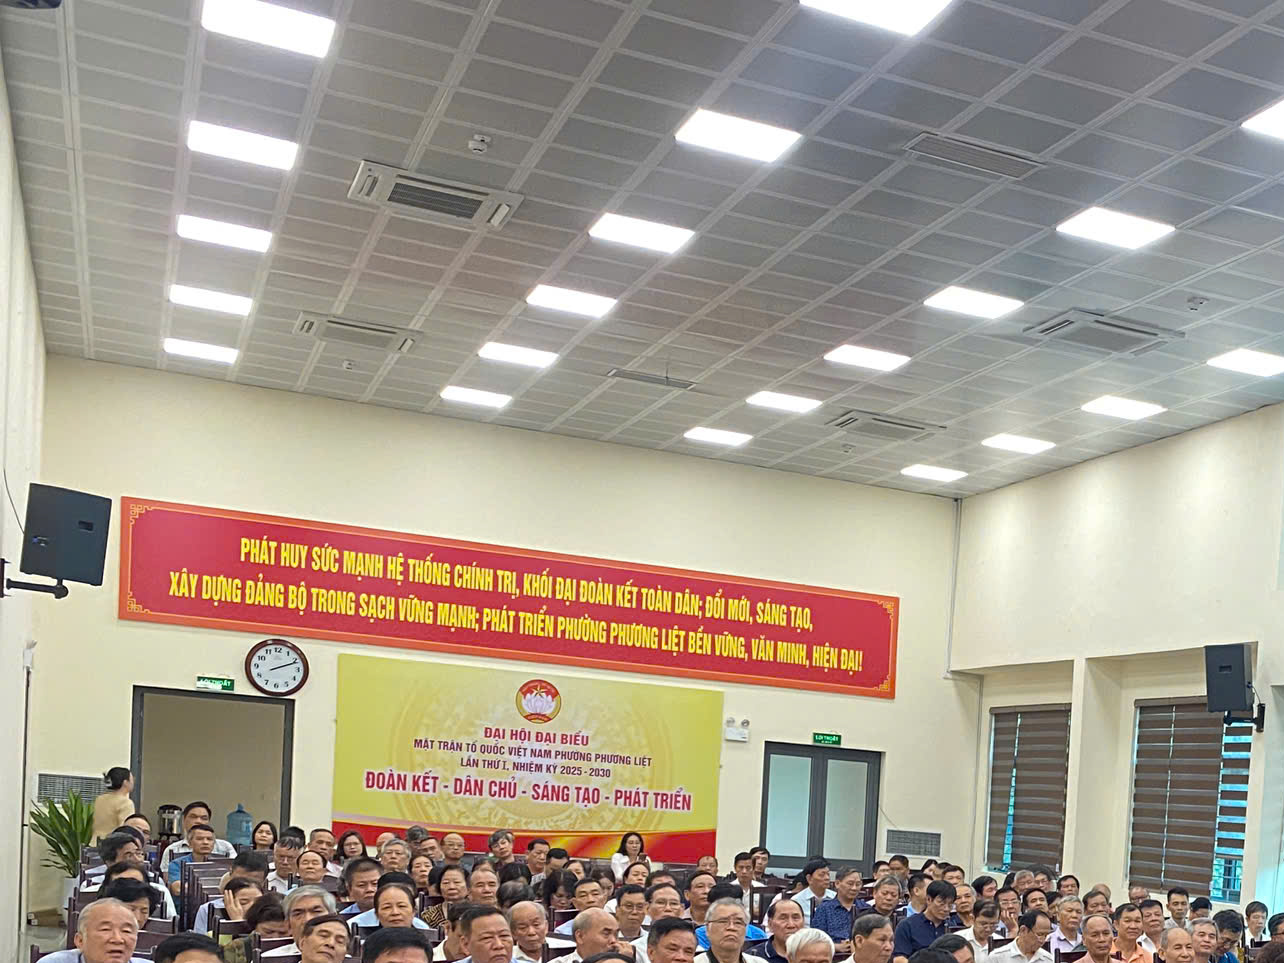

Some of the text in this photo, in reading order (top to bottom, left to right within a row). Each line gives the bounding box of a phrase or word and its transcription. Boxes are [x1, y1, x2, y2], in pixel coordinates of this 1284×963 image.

[240, 535, 813, 633] PHÁT HUY SỨC MẠNH HỆ THỐNG CHÍNH TRỊ, KHỐI ĐẠI ĐOÀN KẾT TOÀN DÂN; ĐỔI MỚI, SÁNG TẠO,
[168, 567, 863, 676] XÂY DỰNG ĐẢNG BỘ TRONG SẠCH VỮNG MẠNH; PHÁT TRIỂN PHƯỜNG PHƯƠNG LIỆT BỀN VỮNG, VĂN MINH, HIỆN ĐẠI!
[413, 738, 435, 752] MẶT
[438, 740, 463, 754] TRẬN
[479, 741, 505, 756] QUỐC
[508, 745, 528, 760] VIỆT
[530, 748, 552, 760] NAM
[554, 749, 592, 763] PHƯỜNG
[594, 753, 631, 766] PHƯƠNG
[634, 756, 652, 769] LIỆT
[484, 727, 589, 747] ĐẠI HỘI ĐẠI BIỂU
[460, 755, 479, 768] LẦN
[482, 758, 501, 770] THỨ
[513, 761, 543, 775] NHIỆM
[545, 763, 558, 774] KỲ
[560, 765, 582, 776] 2025
[589, 767, 611, 778] 2030
[365, 769, 407, 792] ĐOÀN
[412, 770, 440, 794] KẾT
[453, 775, 484, 797] DÂN
[488, 776, 517, 799] CHỦ
[531, 781, 570, 803] SÁNG
[574, 786, 600, 808] TẠO
[614, 788, 649, 808] PHÁT
[653, 787, 692, 811] TRIỂN
